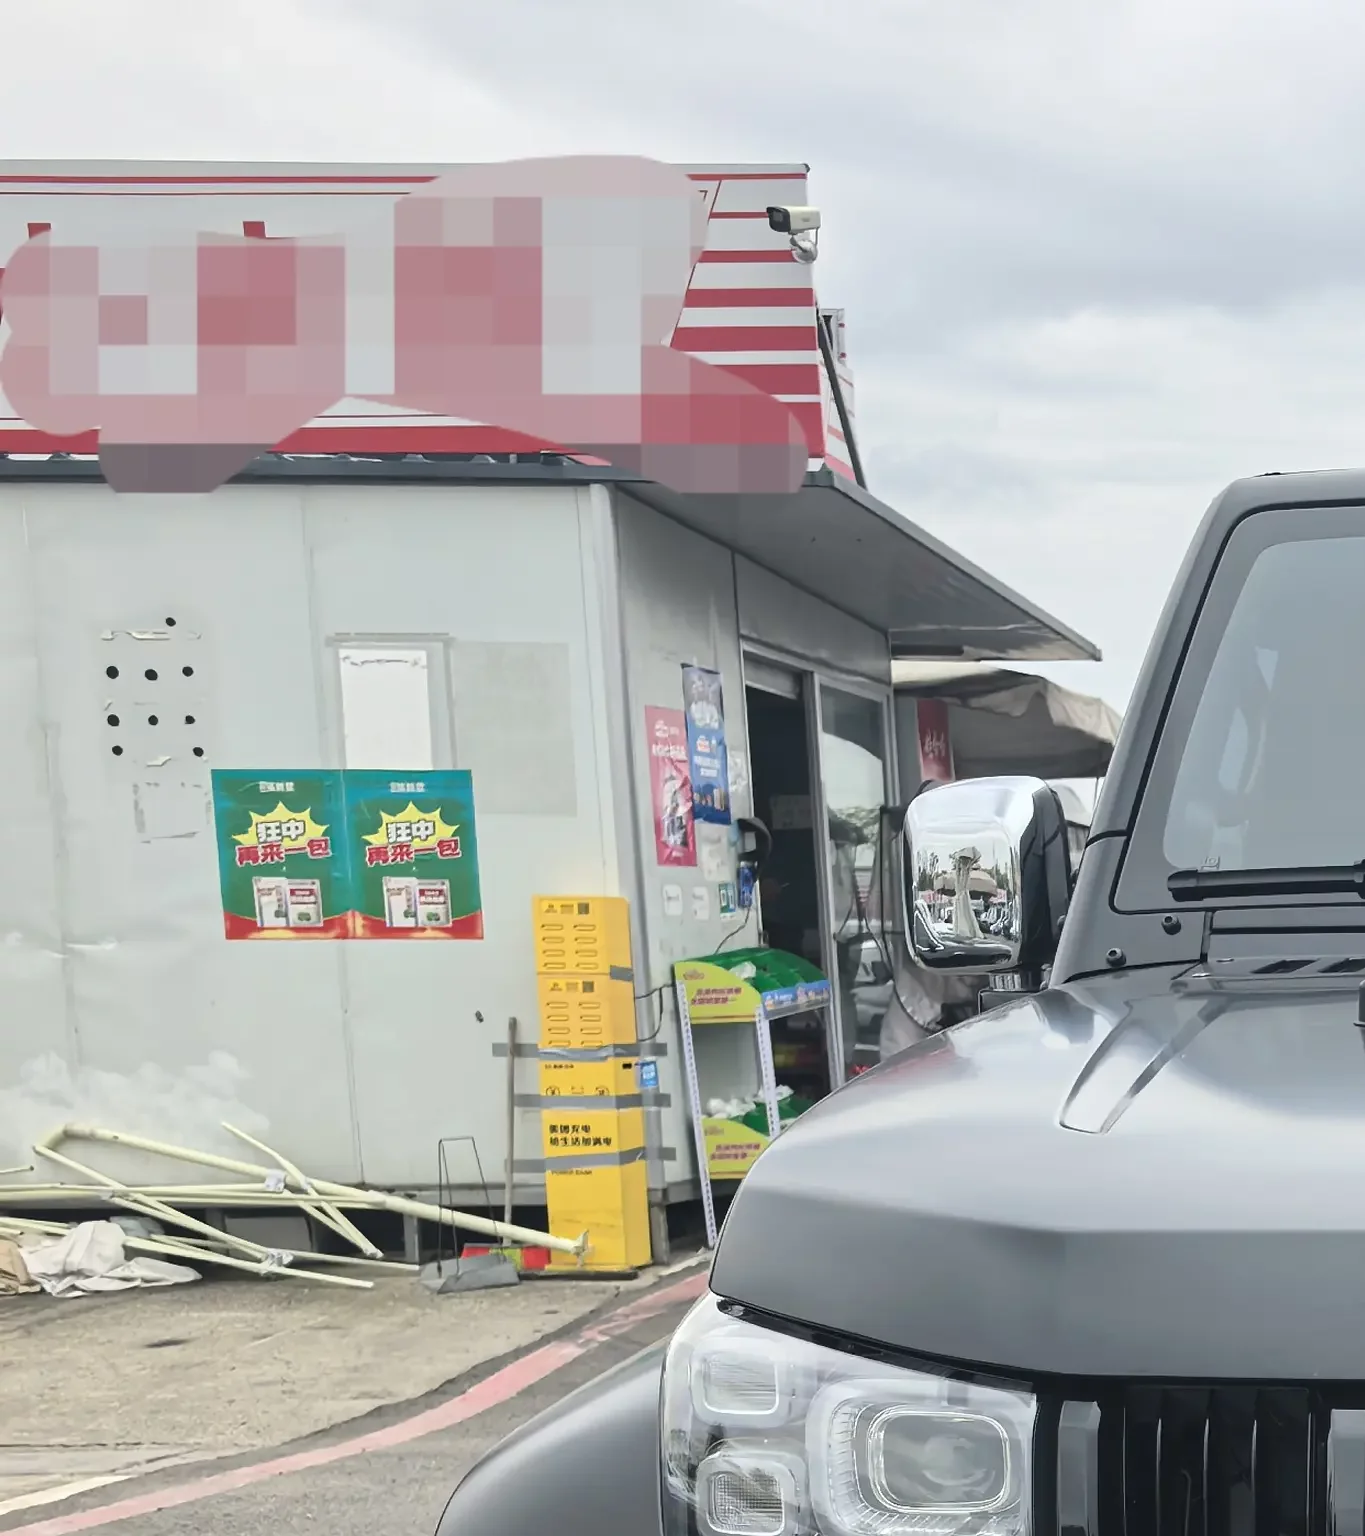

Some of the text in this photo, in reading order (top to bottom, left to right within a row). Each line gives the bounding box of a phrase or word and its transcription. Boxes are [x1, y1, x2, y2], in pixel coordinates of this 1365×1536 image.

[256, 819, 306, 843] 狂中
[386, 819, 436, 843] 狂中
[236, 837, 331, 867] 再来一包
[366, 837, 461, 867] 再来一包
